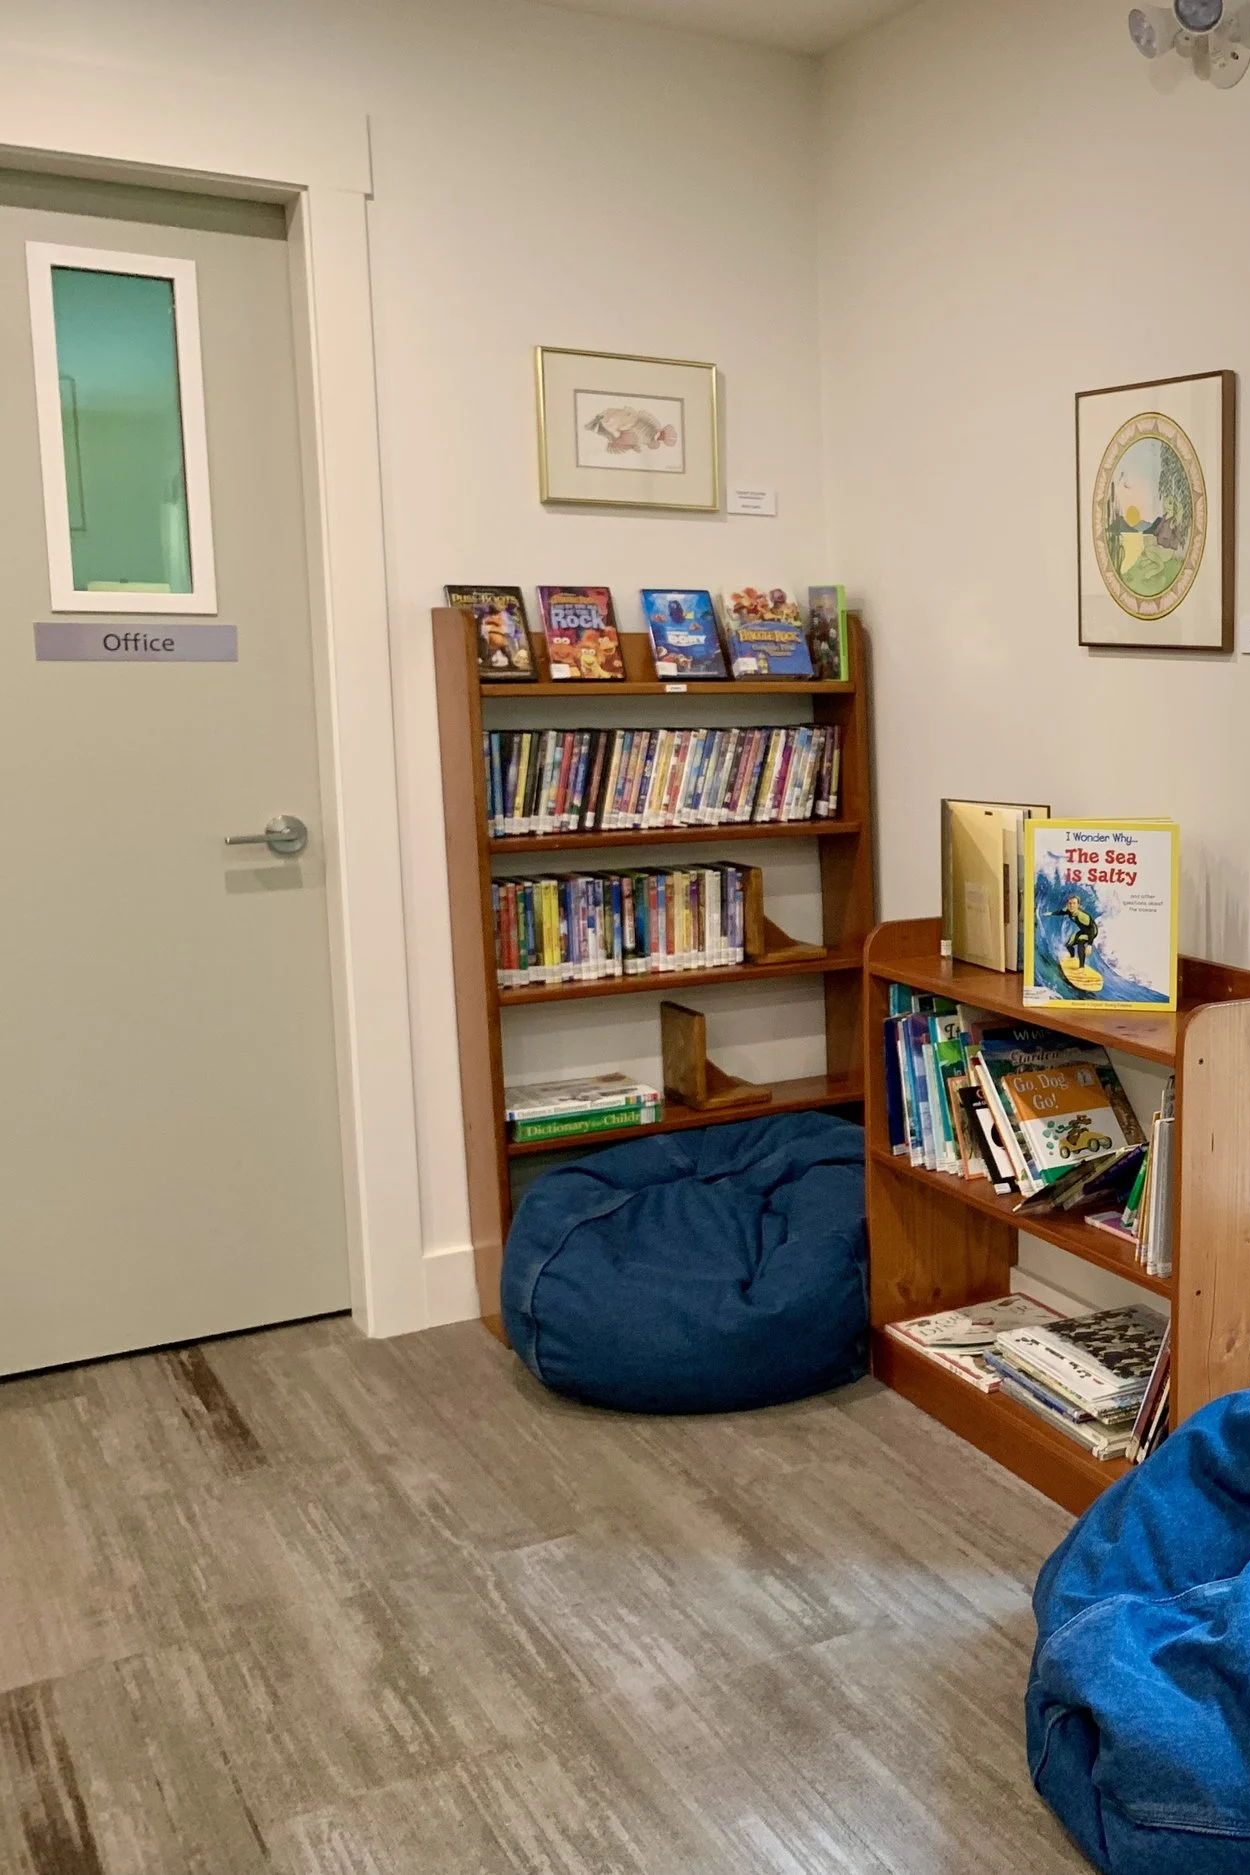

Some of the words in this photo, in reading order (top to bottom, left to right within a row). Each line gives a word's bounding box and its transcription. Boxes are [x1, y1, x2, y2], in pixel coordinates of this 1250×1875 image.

[103, 633, 175, 652] Office
[1066, 832, 1071, 842] I
[1073, 832, 1110, 843] Wonder
[1065, 848, 1100, 864] The
[1105, 849, 1137, 865] Sea
[1066, 868, 1082, 883] is
[1088, 868, 1137, 886] Salty
[1033, 1094, 1058, 1110] Go!
[526, 1119, 590, 1136] Dictionary
[603, 1111, 641, 1126] Childr
